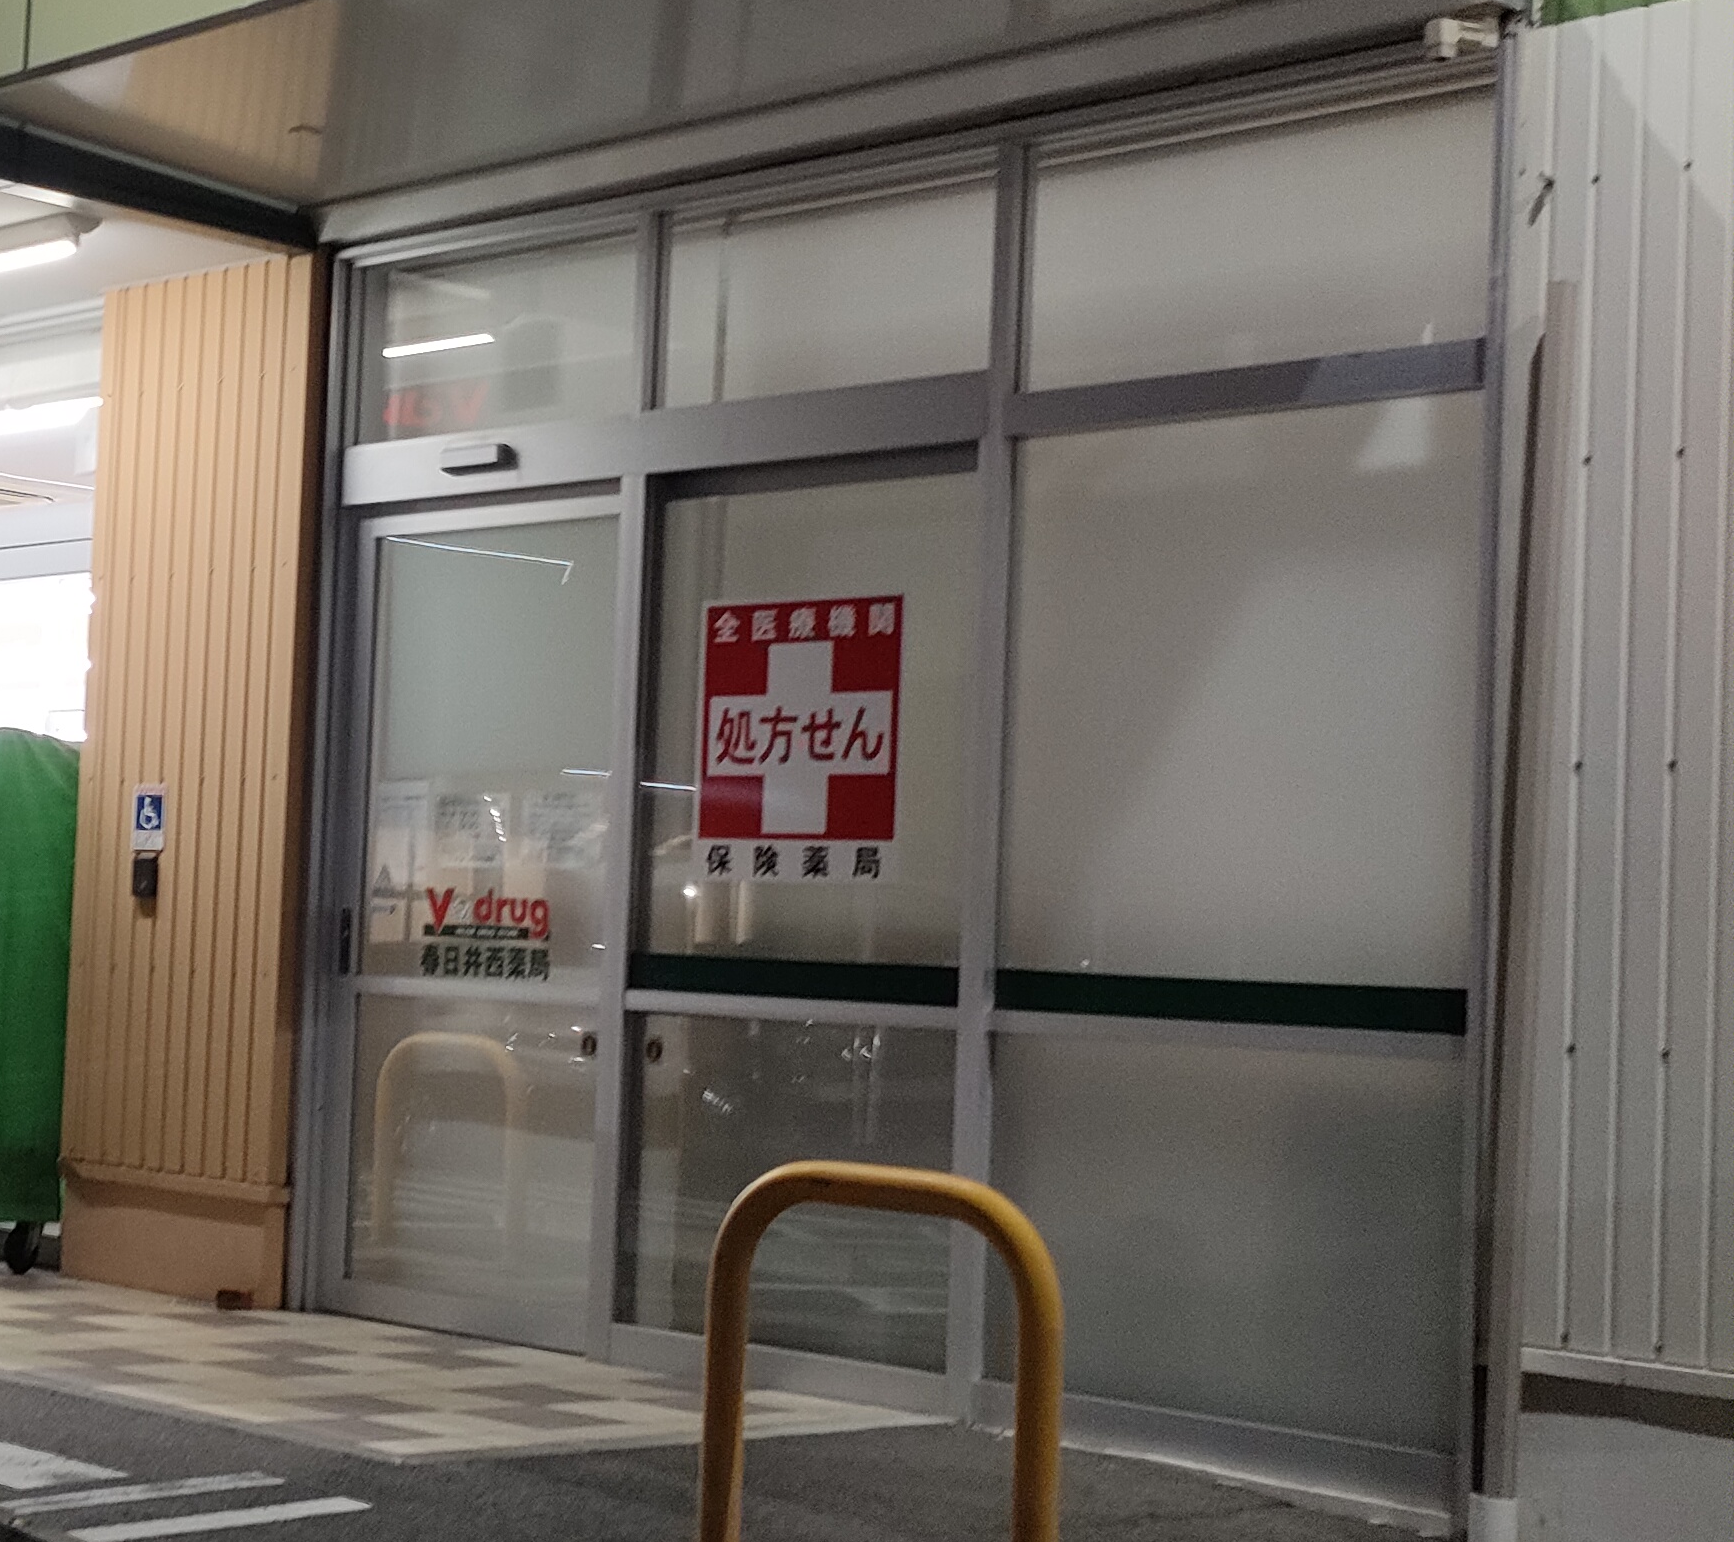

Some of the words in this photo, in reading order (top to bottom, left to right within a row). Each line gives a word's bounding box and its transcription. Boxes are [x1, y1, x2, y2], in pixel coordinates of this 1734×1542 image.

[713, 601, 896, 644] 全医療機関
[716, 706, 885, 766] 処方せん
[706, 843, 882, 880] 保険薬局
